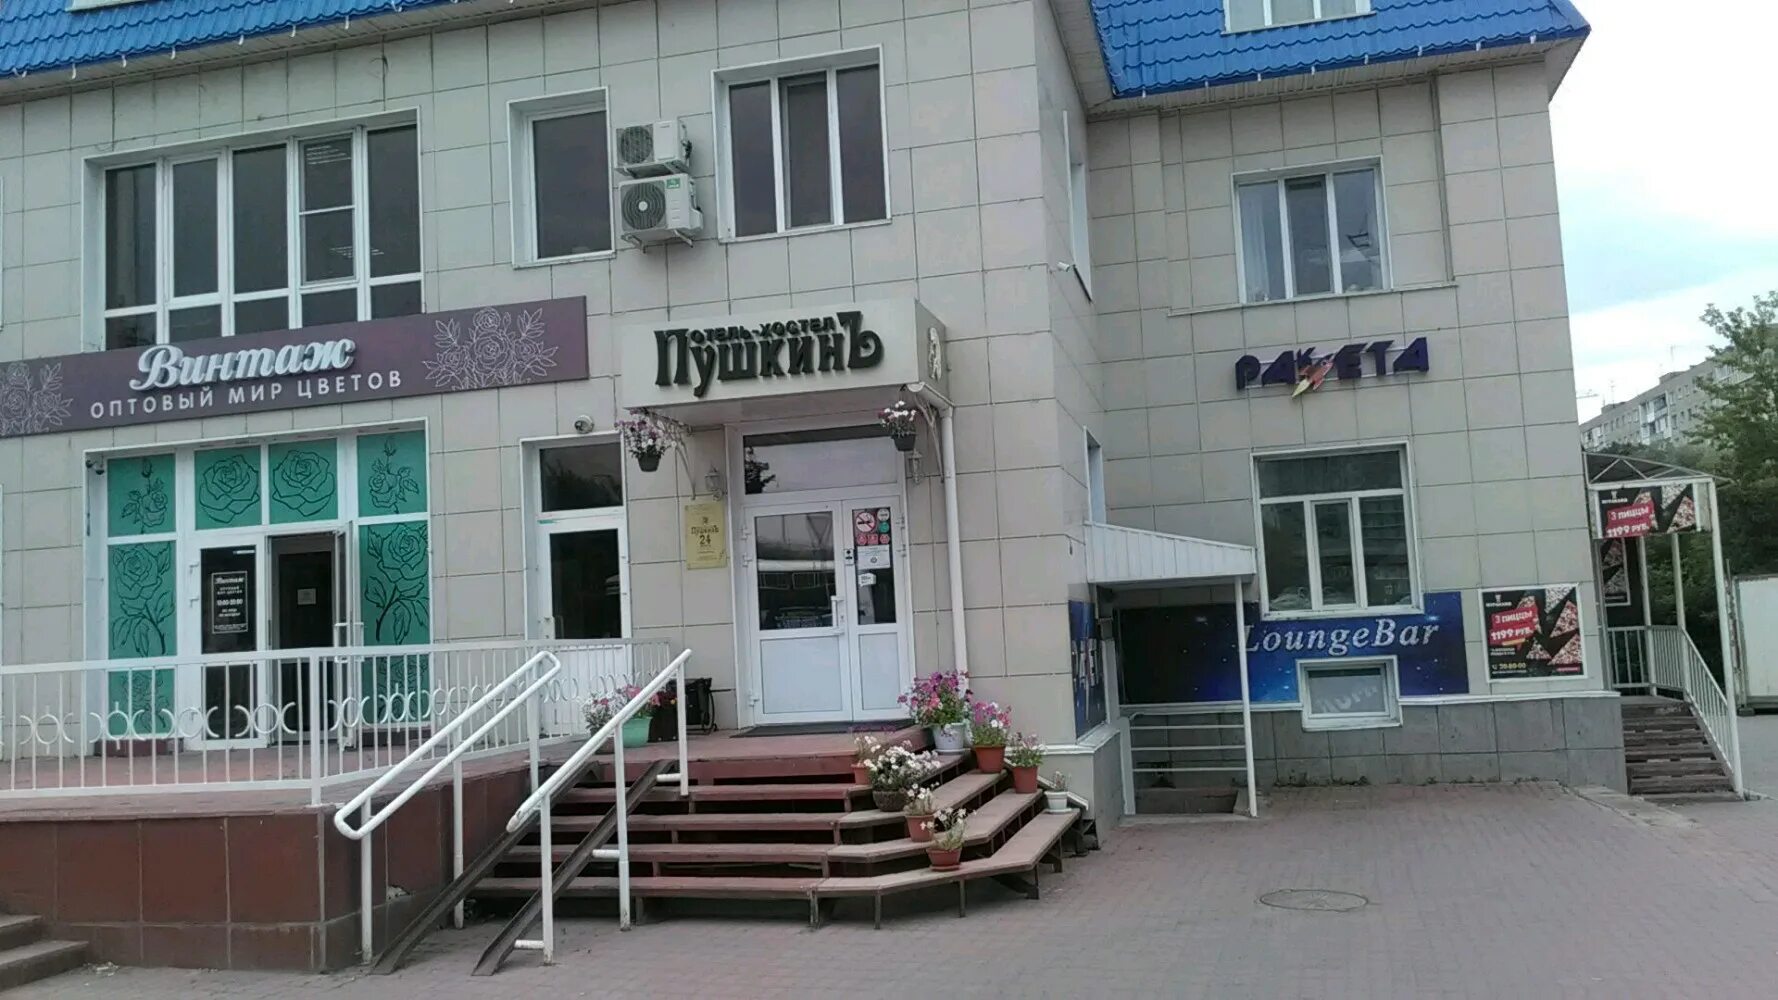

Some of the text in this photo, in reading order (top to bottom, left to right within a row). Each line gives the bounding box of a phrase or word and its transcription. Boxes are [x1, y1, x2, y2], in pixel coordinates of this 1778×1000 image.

[129, 337, 356, 391] Винтаж
[1235, 337, 1429, 390] РАКЕТА
[90, 371, 402, 419] ОПТОВЫЙ МИР ЦВЕТОВ
[699, 534, 711, 545] 24
[1606, 525, 1630, 538] 1199
[1245, 618, 1439, 656] LoungeBar
[1491, 628, 1513, 641] 1199
